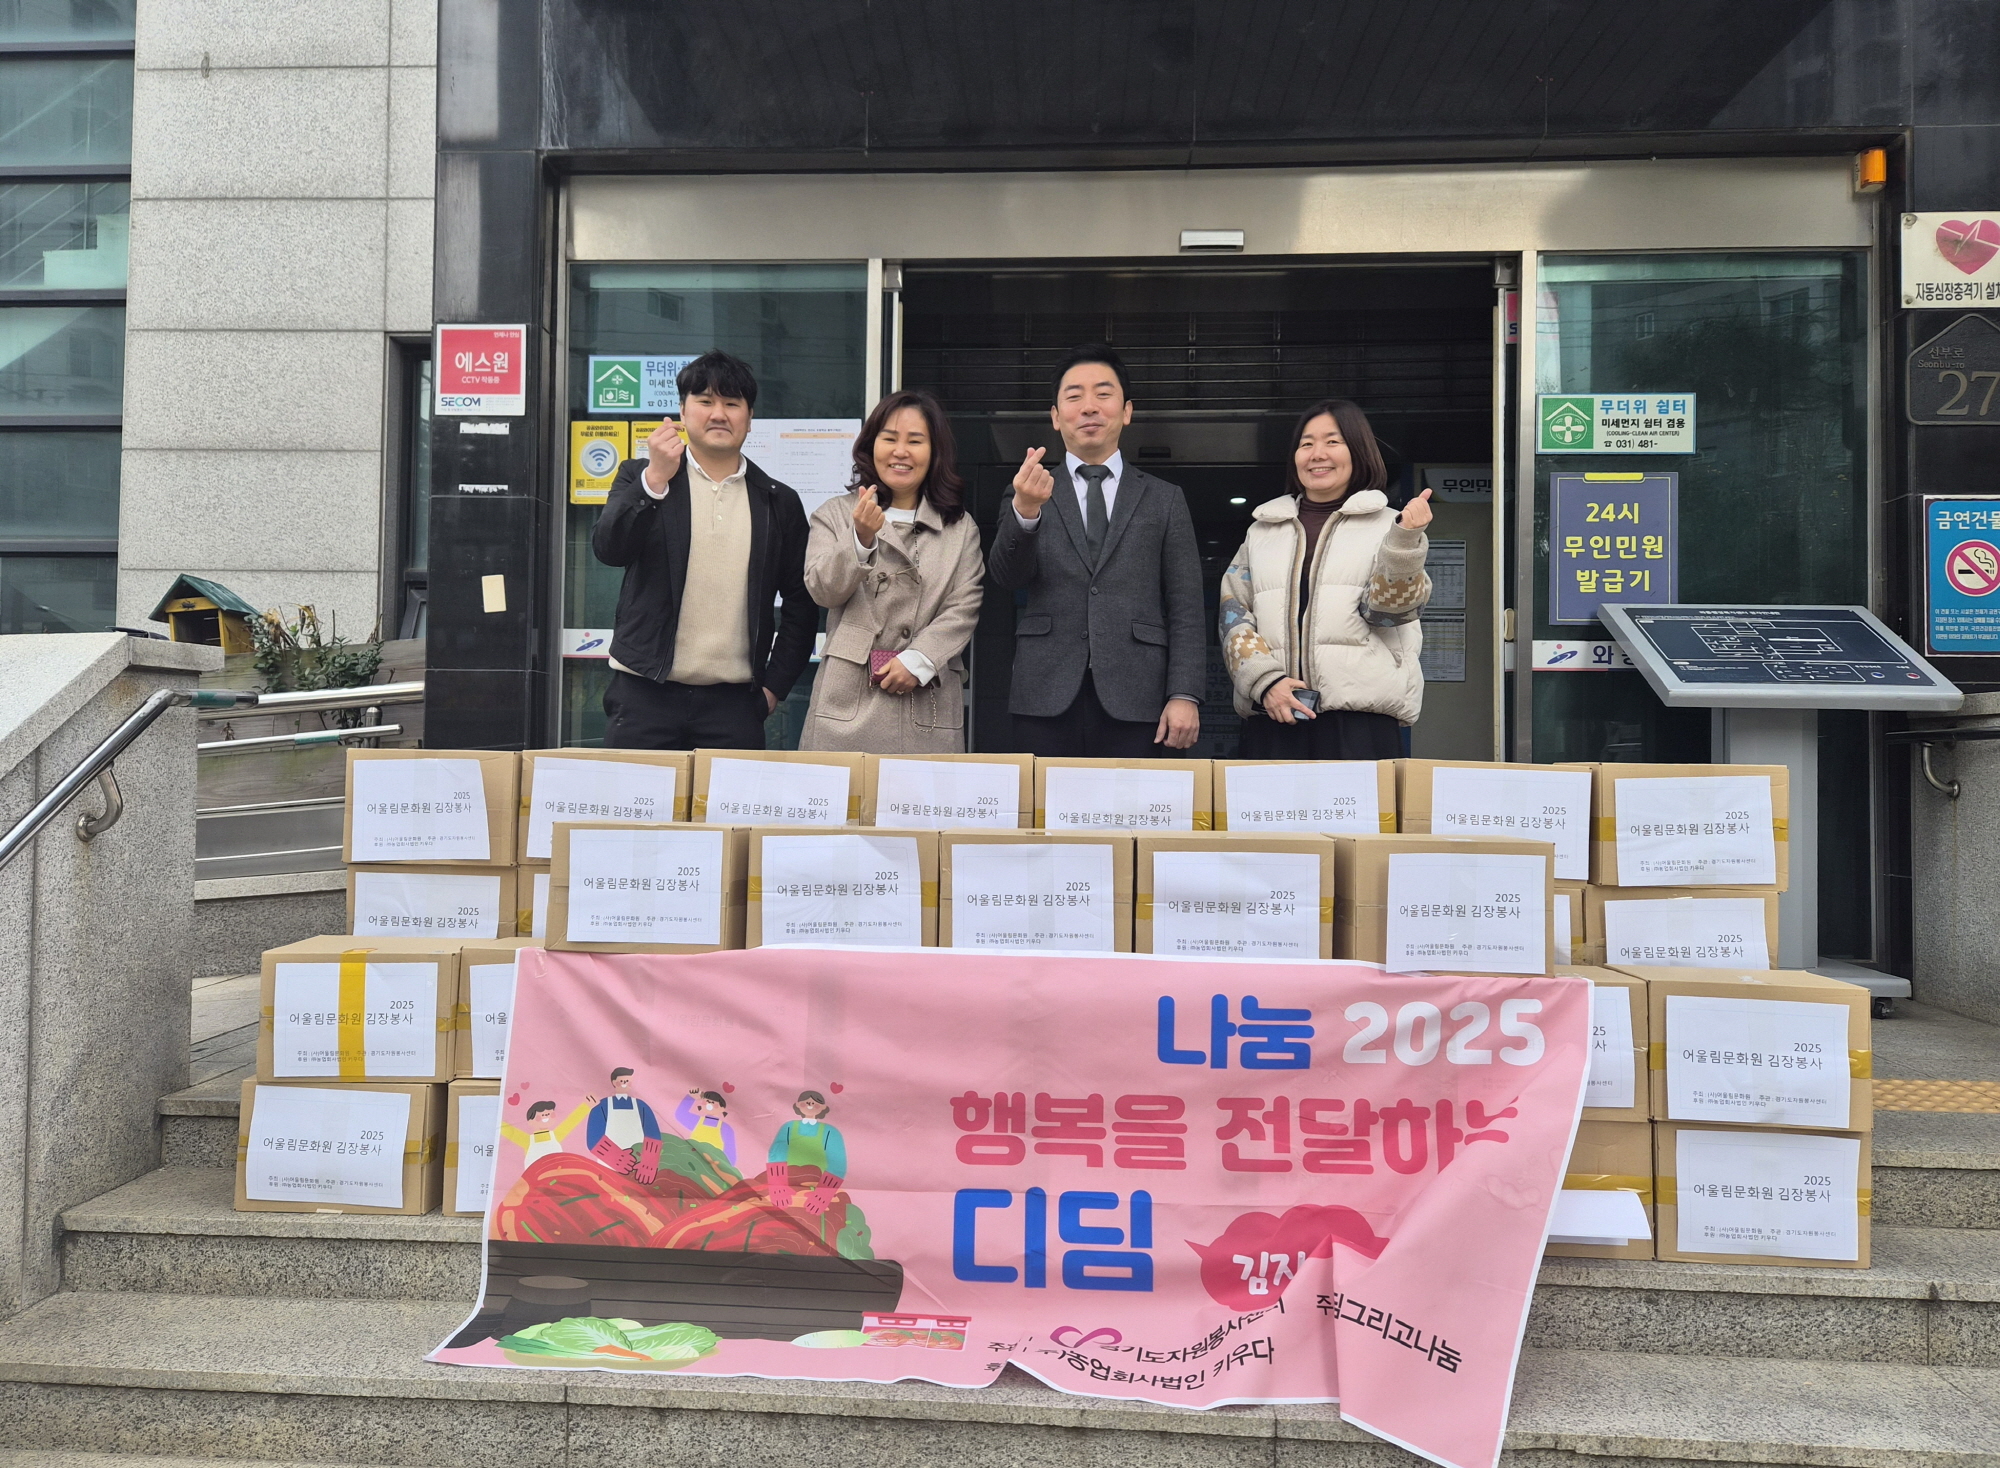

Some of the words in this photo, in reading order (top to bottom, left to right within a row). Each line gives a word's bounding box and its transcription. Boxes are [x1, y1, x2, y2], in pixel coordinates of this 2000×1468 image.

[1915, 282, 1983, 301] 자동심장충격기
[1928, 347, 1965, 359] 선부로
[455, 352, 509, 373] 에스원
[1917, 359, 1965, 369] Seonbu-ro
[461, 376, 480, 384] CCTV
[649, 379, 678, 388] 미세먼
[1936, 370, 2000, 416] 27
[441, 397, 481, 407] SECOM
[1600, 399, 1648, 415] 무더위
[1656, 399, 1686, 415] 쉼터
[1601, 418, 1640, 429] 미세먼지
[1643, 418, 1663, 429] 쉼터
[1666, 418, 1686, 429] 겸용
[1616, 439, 1635, 449] 031)
[1442, 478, 1493, 493] 무인민
[1586, 502, 1639, 524] 24시
[1563, 535, 1663, 559] 무인민원
[1576, 569, 1650, 593] 발급기
[633, 797, 654, 806] 2025
[808, 798, 828, 806] 2025
[977, 797, 998, 805] 2025
[1334, 797, 1356, 805] 2025
[367, 803, 430, 814] 어울림문화원
[435, 803, 471, 813] 김장봉사
[545, 802, 609, 815] 어울림문화원
[613, 806, 654, 818] 김장봉사
[720, 803, 782, 817] 어울림문화원
[787, 807, 828, 819] 김장봉사
[891, 804, 952, 817] 어울림문화원
[957, 807, 997, 818] 김장봉사
[1149, 804, 1171, 812] 2025
[1542, 806, 1566, 815] 2025
[1059, 813, 1124, 825] 어울림문화원
[1128, 814, 1171, 828] 김장봉사
[1241, 810, 1307, 821] 어울림문화원
[1312, 809, 1356, 820] 김장봉사
[1725, 811, 1749, 819] 2025
[1446, 814, 1514, 827] 어울림문화원
[1520, 815, 1566, 829] 김장봉사
[1631, 824, 1698, 836] 어울림문화원
[1703, 823, 1749, 834] 김장봉사
[678, 867, 700, 876] 2025
[875, 872, 898, 880] 2025
[584, 878, 651, 890] 어울림문화원
[656, 878, 699, 891] 김장봉사
[777, 884, 847, 896] 어울림문화원
[852, 884, 898, 895] 김장봉사
[1066, 882, 1090, 891] 2025
[967, 894, 1038, 906] 어울림문화원
[1043, 895, 1090, 906] 김장봉사
[1270, 891, 1295, 899] 2025
[1496, 894, 1520, 902] 2025
[458, 907, 479, 916] 2025
[1169, 901, 1241, 914] 어울림문화원
[1246, 902, 1295, 915] 김장봉사
[1400, 905, 1466, 917] 어울림문화원
[1471, 906, 1520, 918] 김장봉사
[369, 916, 432, 927] 어울림문화원
[437, 917, 478, 928] 김장봉사
[1621, 947, 1690, 958] 어울림문화원
[1696, 946, 1743, 958] 김장봉사
[390, 1001, 414, 1009] 2025
[290, 1012, 362, 1026] 어울림문화원
[366, 1013, 413, 1025] 김장봉사
[1157, 994, 1314, 1070] 나눔
[1342, 999, 1545, 1066] 2025
[1794, 1043, 1821, 1053] 2025
[1683, 1050, 1762, 1066] 어울림문화원
[1768, 1054, 1822, 1069] 김장봉사
[361, 1131, 383, 1140] 2025
[950, 1091, 1187, 1170] 행복을
[264, 1138, 332, 1153] 어울림문화원
[337, 1142, 381, 1155] 김장봉사
[1804, 1176, 1831, 1186] 2025
[1694, 1184, 1772, 1200] 어울림문화원
[1779, 1188, 1831, 1202] 김장봉사
[953, 1187, 1154, 1292] 디딤
[1213, 1337, 1275, 1378] 키우다
